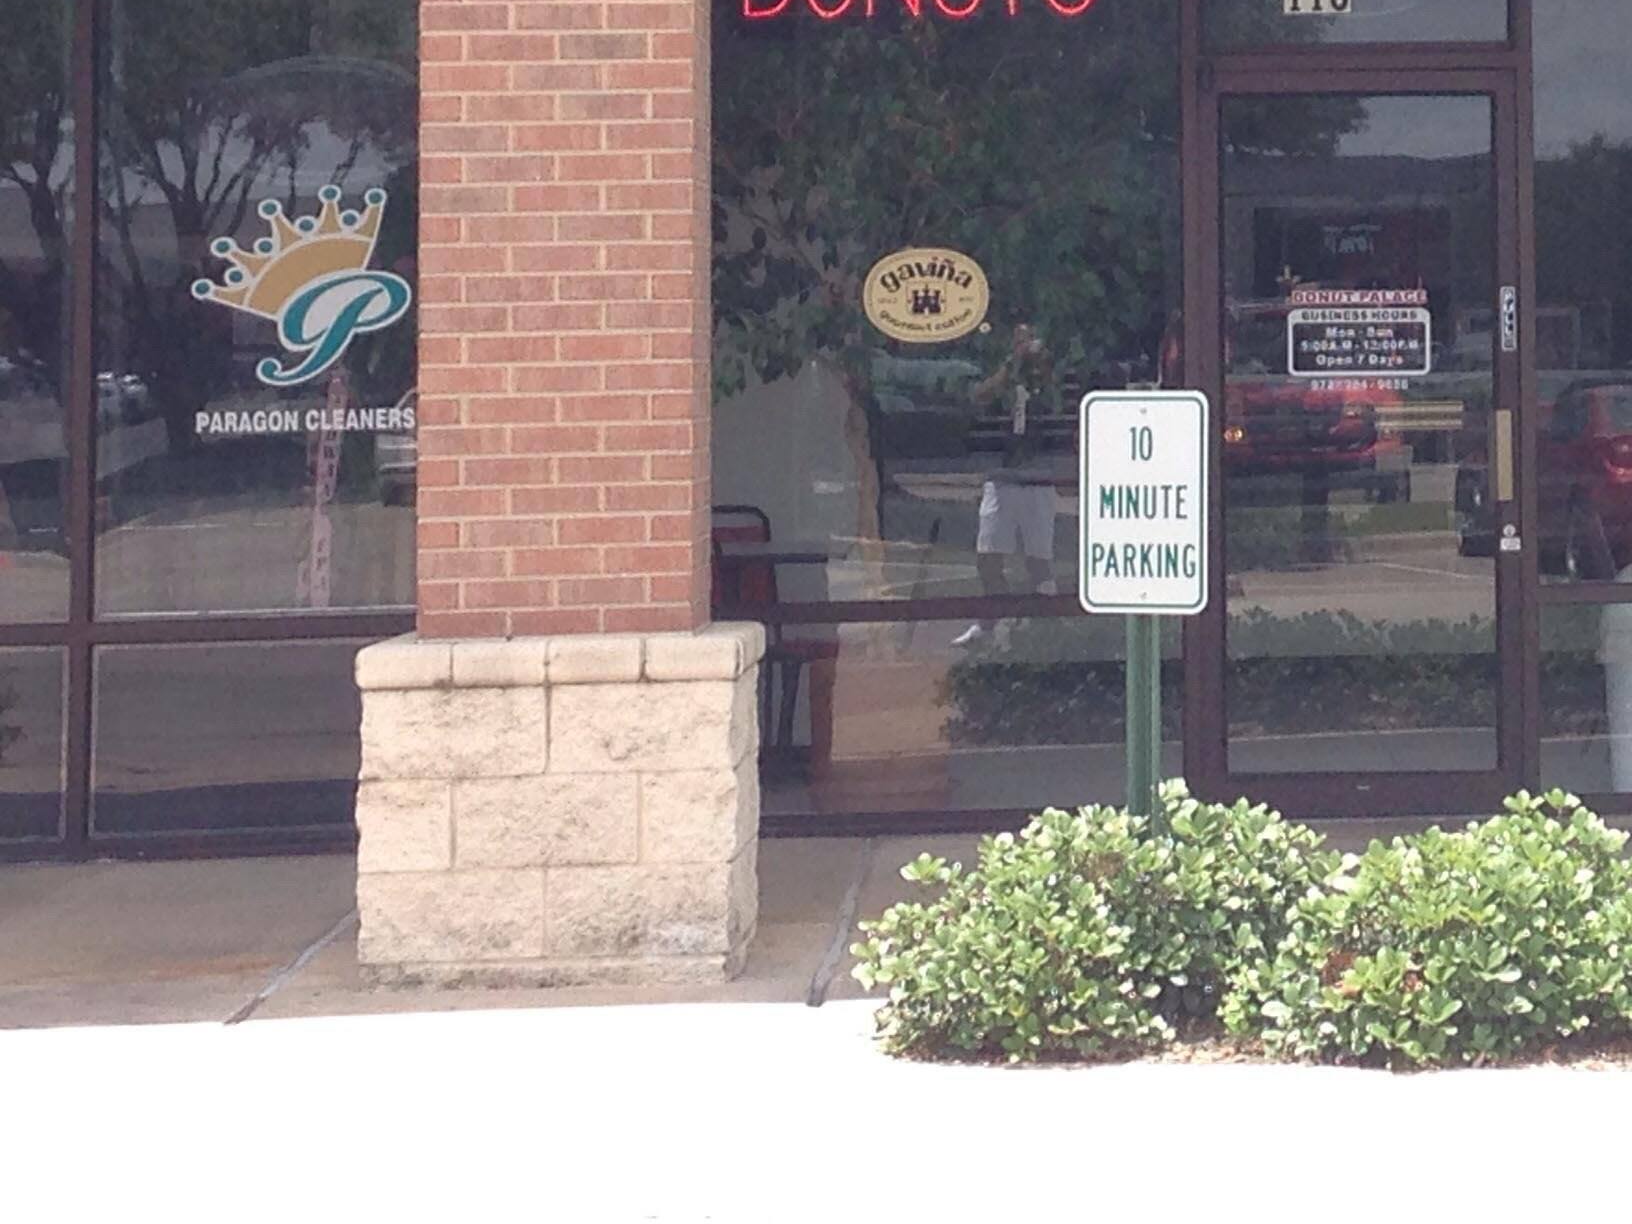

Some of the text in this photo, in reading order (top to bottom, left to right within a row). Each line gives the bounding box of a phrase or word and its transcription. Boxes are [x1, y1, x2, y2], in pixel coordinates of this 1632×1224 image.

[880, 256, 973, 293] gaviña
[1293, 290, 1427, 304] DONUT PALACE
[1301, 309, 1418, 321] BUSINESS HOURS
[1316, 354, 1353, 367] Open
[195, 407, 415, 433] PARAGON CLEANERS
[1130, 426, 1153, 461] 10
[1099, 484, 1188, 520] MINUTE
[1091, 543, 1197, 579] PARKING
